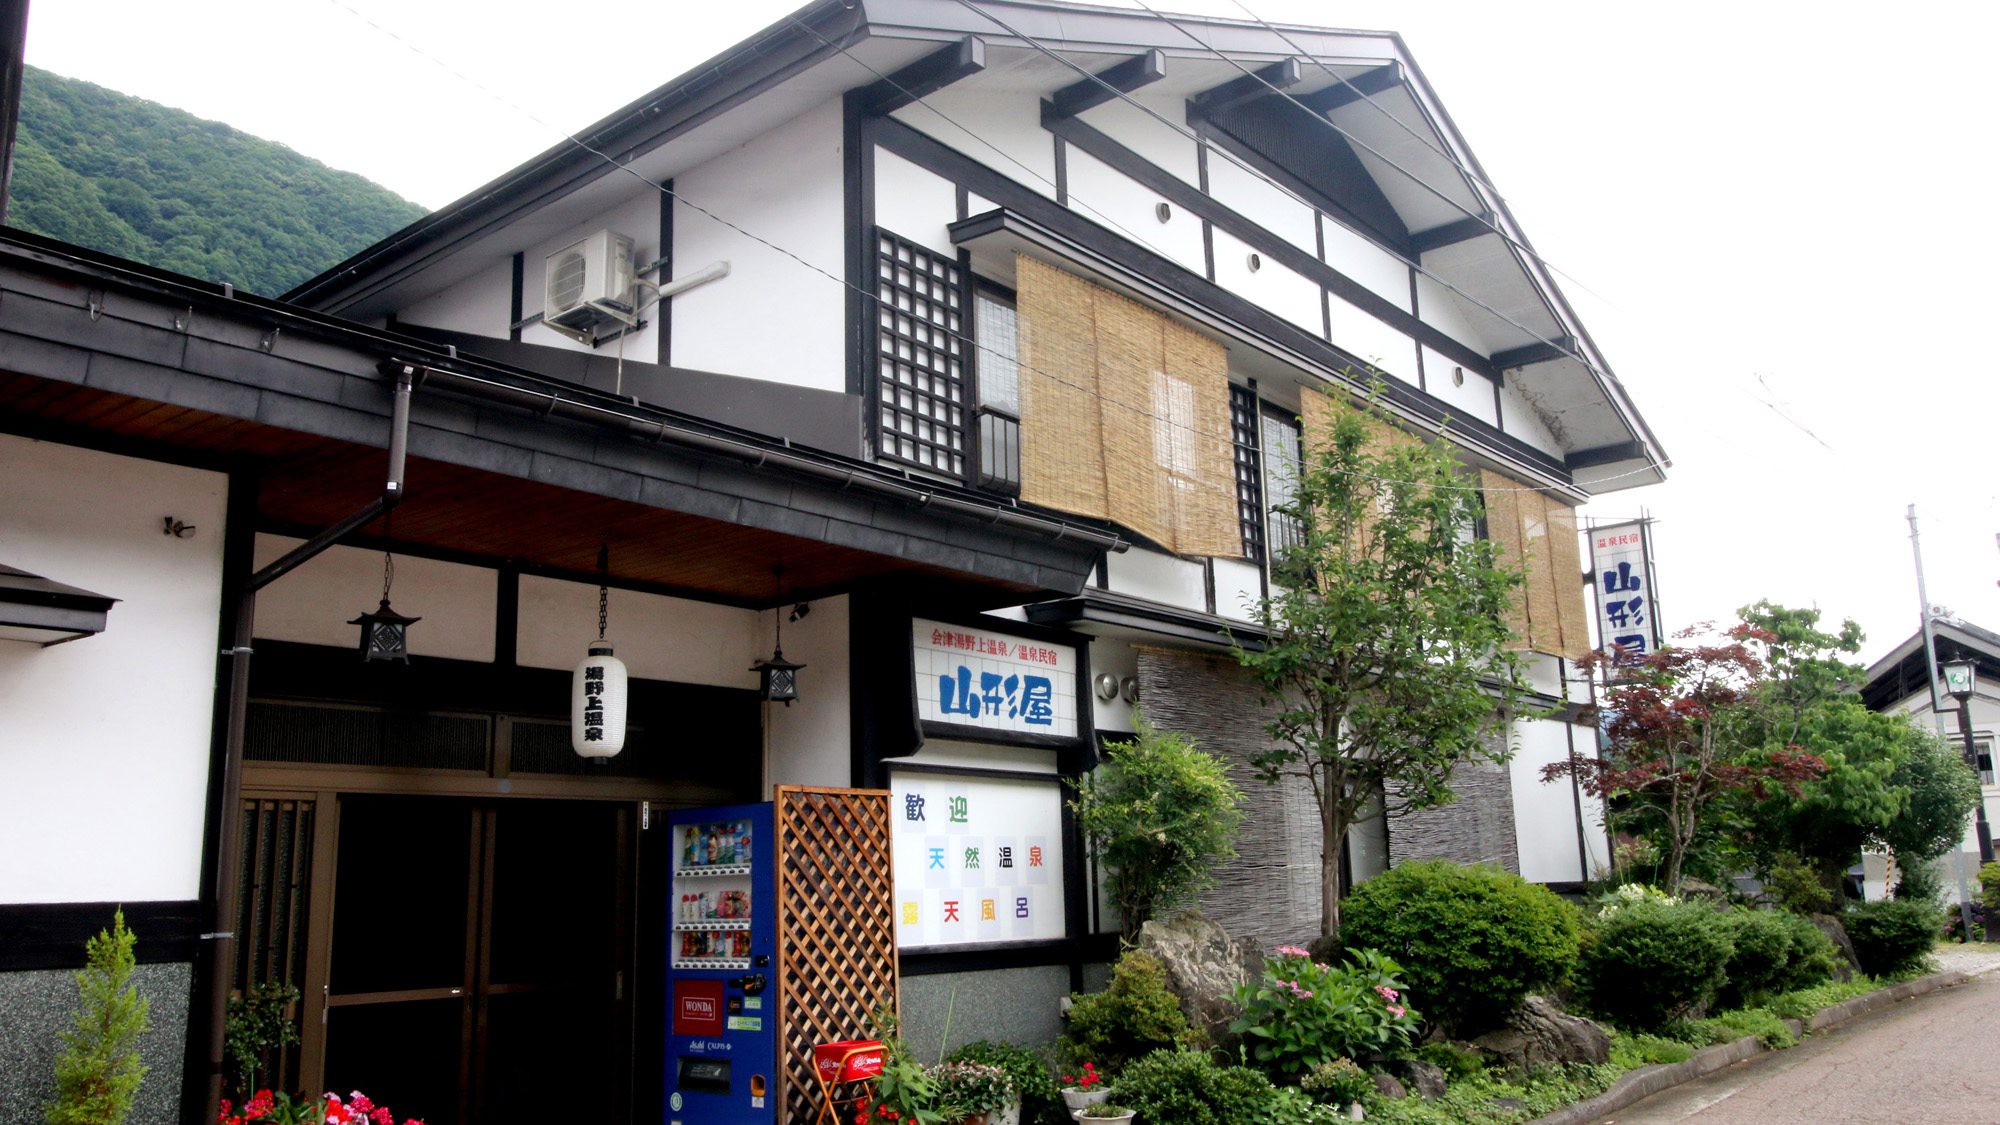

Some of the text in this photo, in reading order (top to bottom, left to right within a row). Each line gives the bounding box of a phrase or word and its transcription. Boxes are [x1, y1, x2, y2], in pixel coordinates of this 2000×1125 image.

[1597, 533, 1639, 549] 温泉民宿
[584, 666, 605, 742] 湯野上温泉
[939, 665, 1053, 726] 山形屋
[905, 793, 968, 823] 歓迎
[929, 846, 1043, 869] 天然温泉
[902, 897, 1029, 926] 露天風呂
[685, 1001, 712, 1012] WONDA
